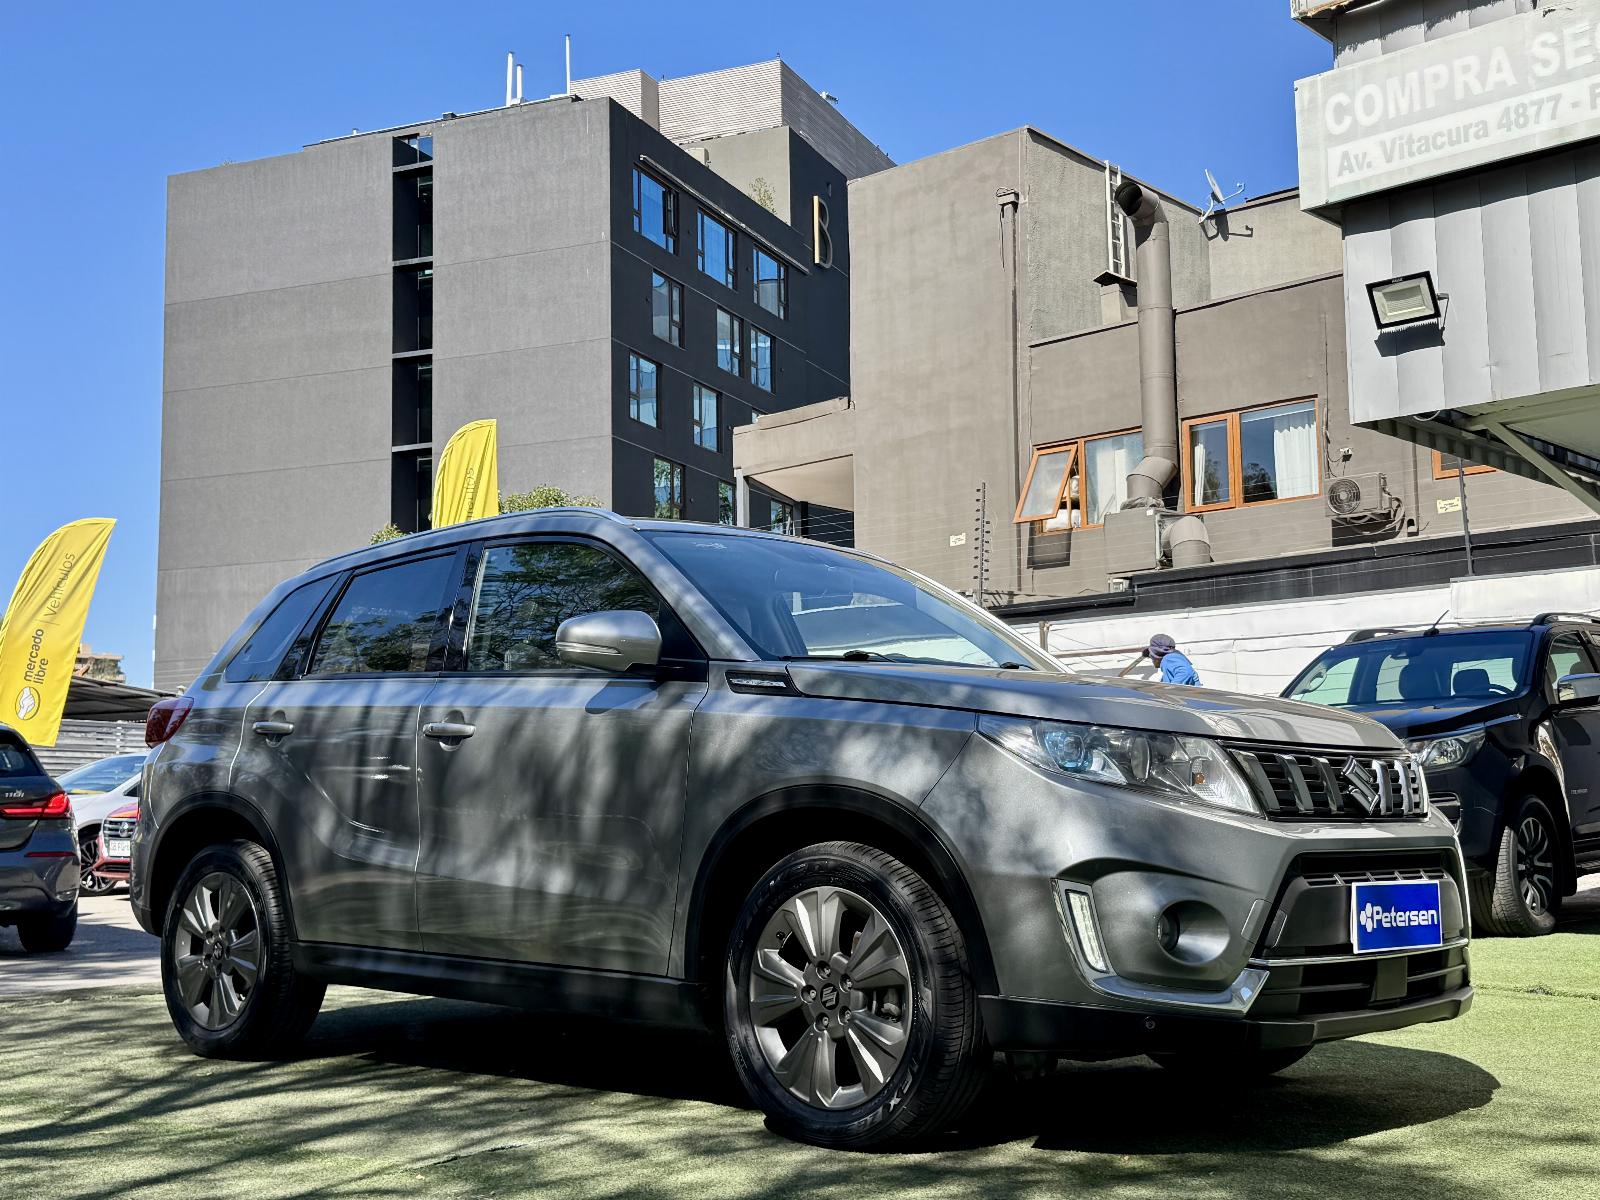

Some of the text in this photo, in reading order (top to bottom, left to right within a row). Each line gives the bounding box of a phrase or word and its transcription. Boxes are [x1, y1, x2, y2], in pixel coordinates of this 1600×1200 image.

[1325, 19, 1600, 136] COMPRA SE
[1337, 150, 1373, 177] Av.
[1380, 120, 1489, 163] Vitacura
[1497, 93, 1563, 132] 4877
[23, 628, 45, 683] mercado
[32, 658, 49, 685] libre
[1372, 905, 1438, 929] Petersen
